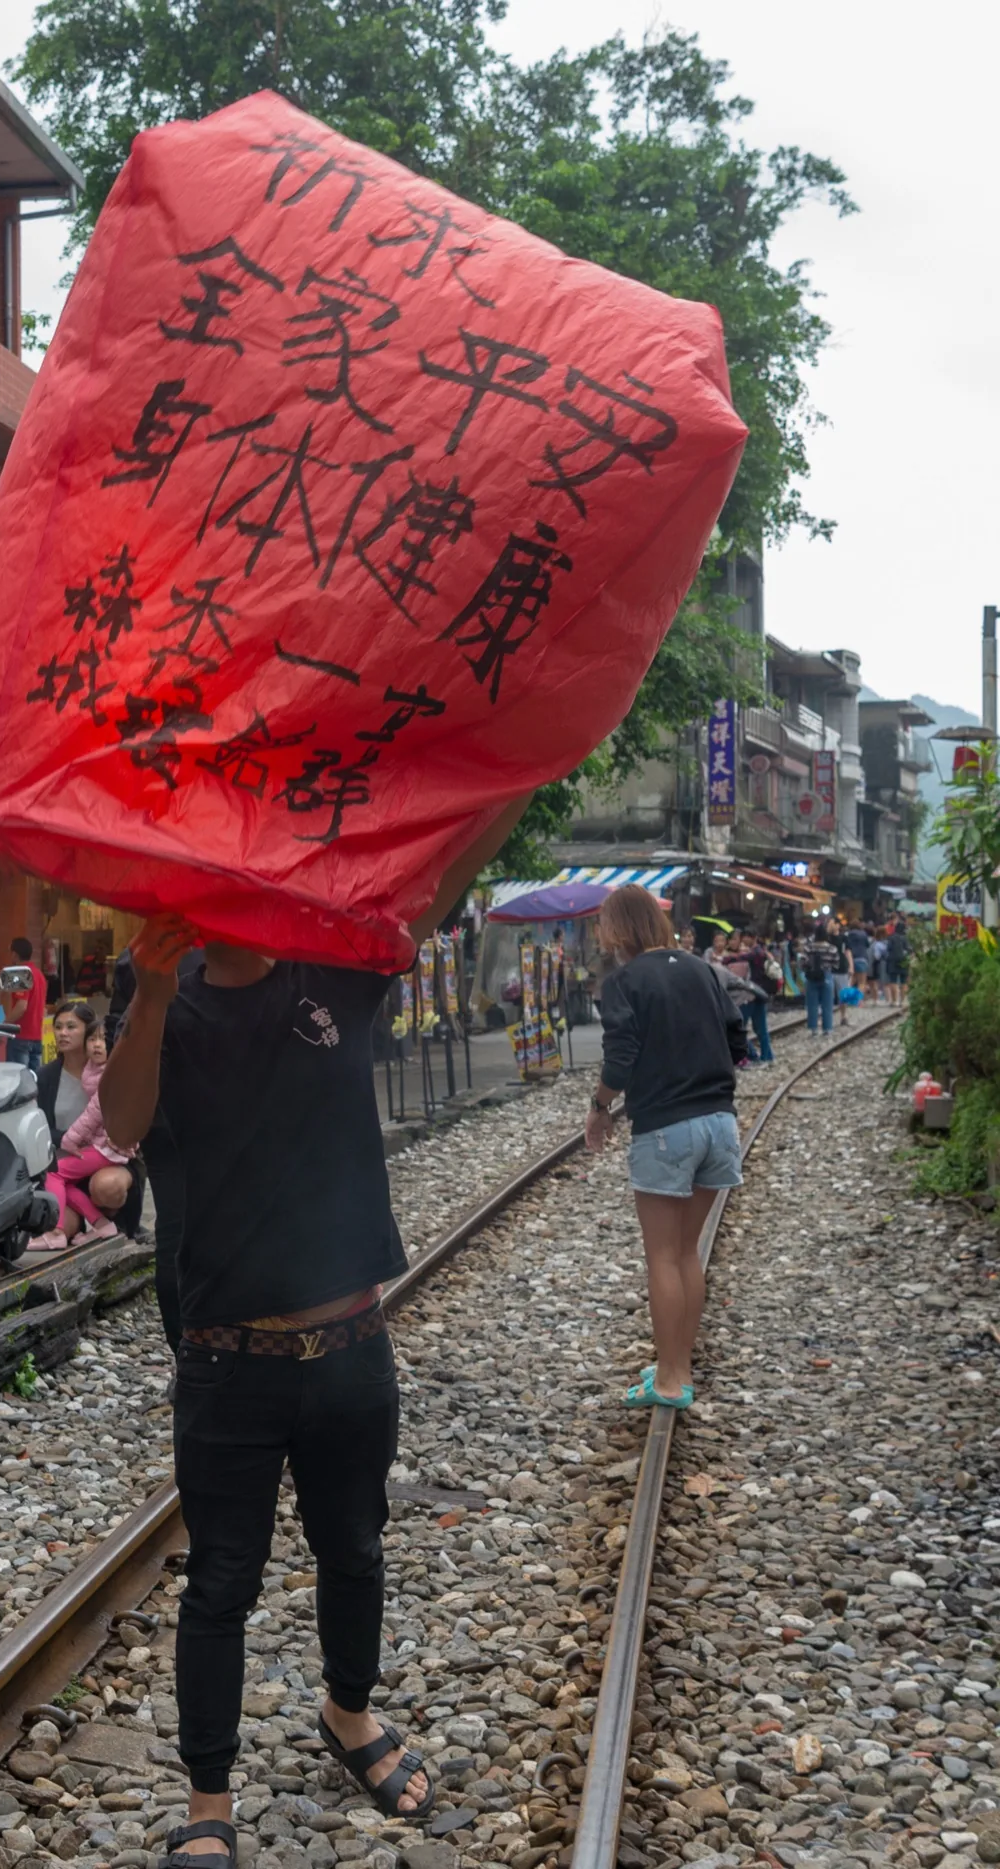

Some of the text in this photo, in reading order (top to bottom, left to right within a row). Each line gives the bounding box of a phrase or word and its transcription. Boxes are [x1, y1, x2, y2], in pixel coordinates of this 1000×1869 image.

[249, 133, 496, 309] 祈求
[158, 236, 680, 519] 全家平安
[101, 379, 573, 705] 身体健康
